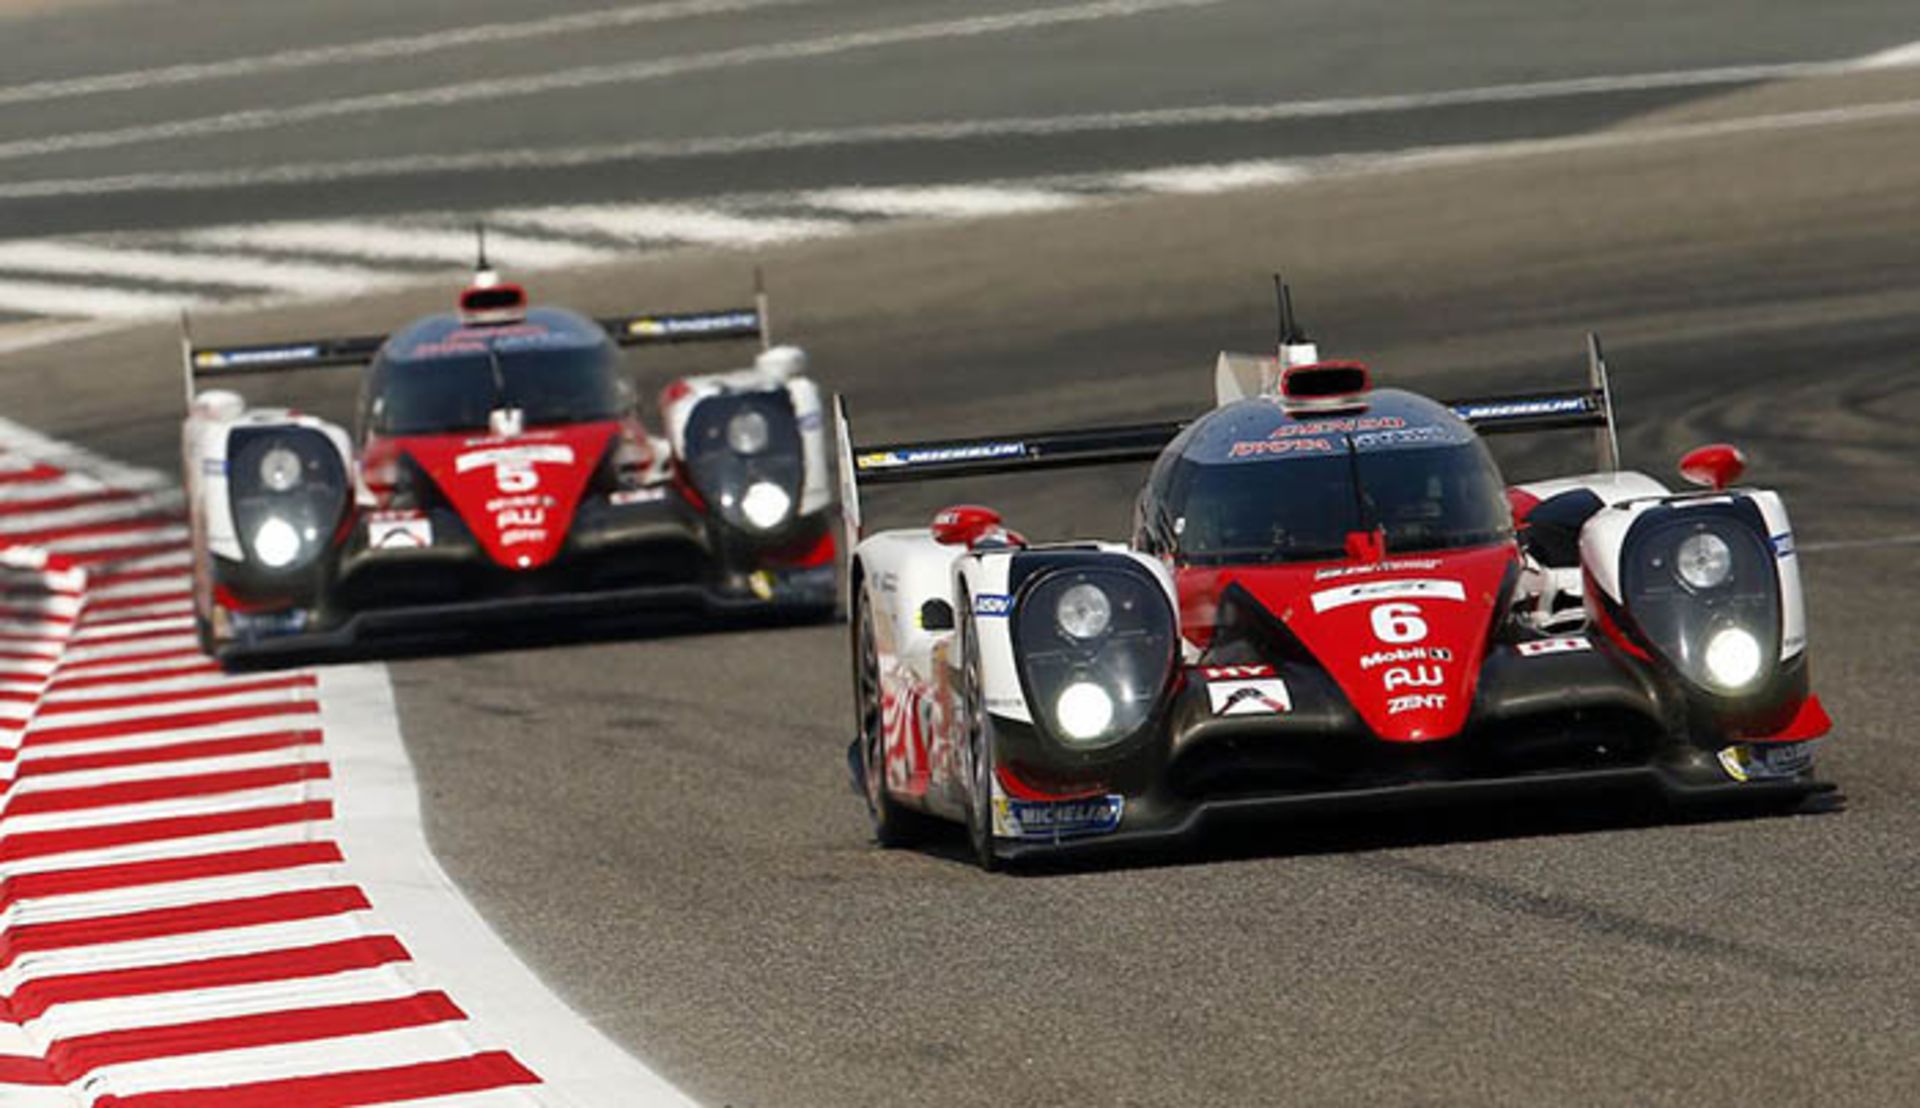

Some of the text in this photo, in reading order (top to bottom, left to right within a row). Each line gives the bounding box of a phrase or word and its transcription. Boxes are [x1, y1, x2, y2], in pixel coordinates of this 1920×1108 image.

[908, 443, 1019, 462] MICHELIN
[496, 461, 538, 493] 5
[1370, 602, 1428, 644] 6
[1360, 647, 1426, 669] Mobil
[1388, 693, 1447, 714] ZENT
